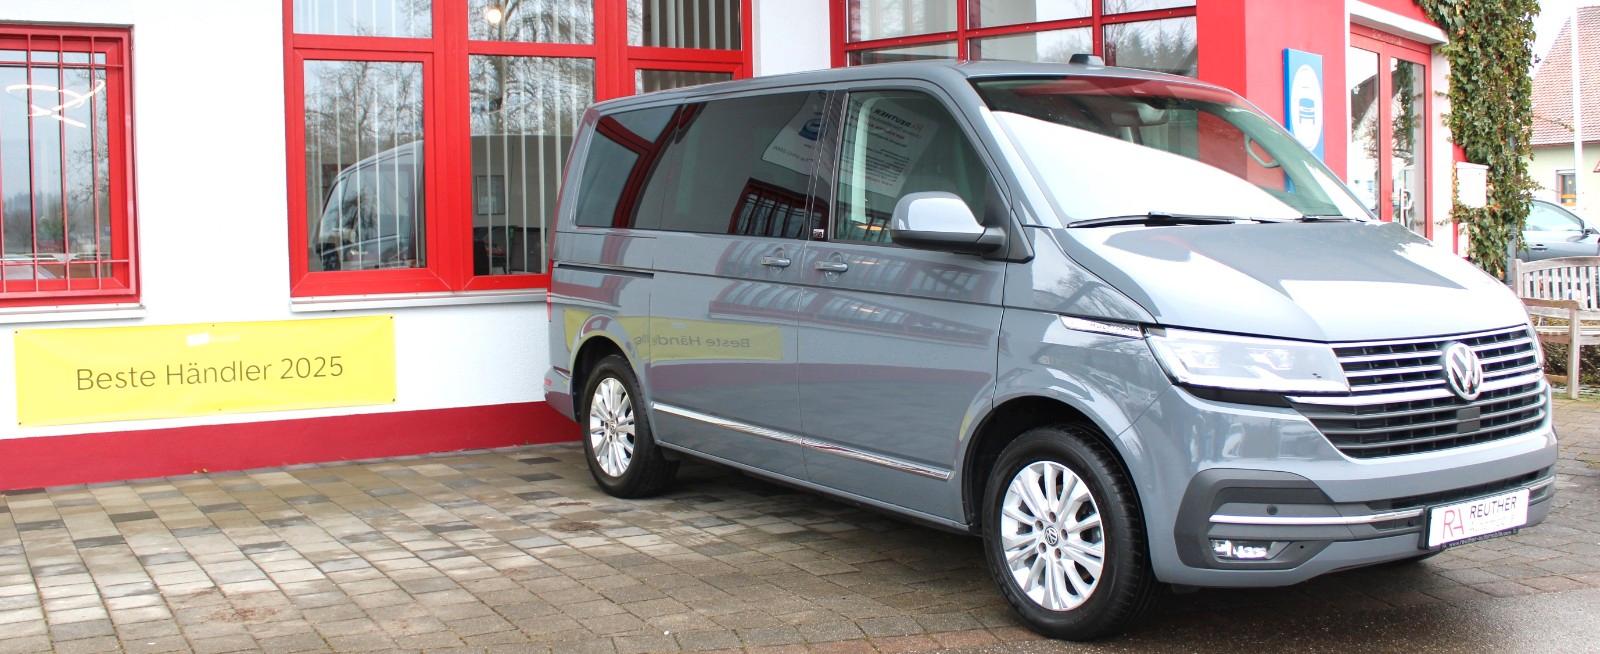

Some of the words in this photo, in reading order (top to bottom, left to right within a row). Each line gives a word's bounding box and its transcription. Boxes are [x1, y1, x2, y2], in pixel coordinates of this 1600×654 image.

[76, 367, 156, 391] Beste
[165, 361, 273, 386] Händler
[280, 355, 344, 380] 2025
[1469, 496, 1517, 520] REUTHER
